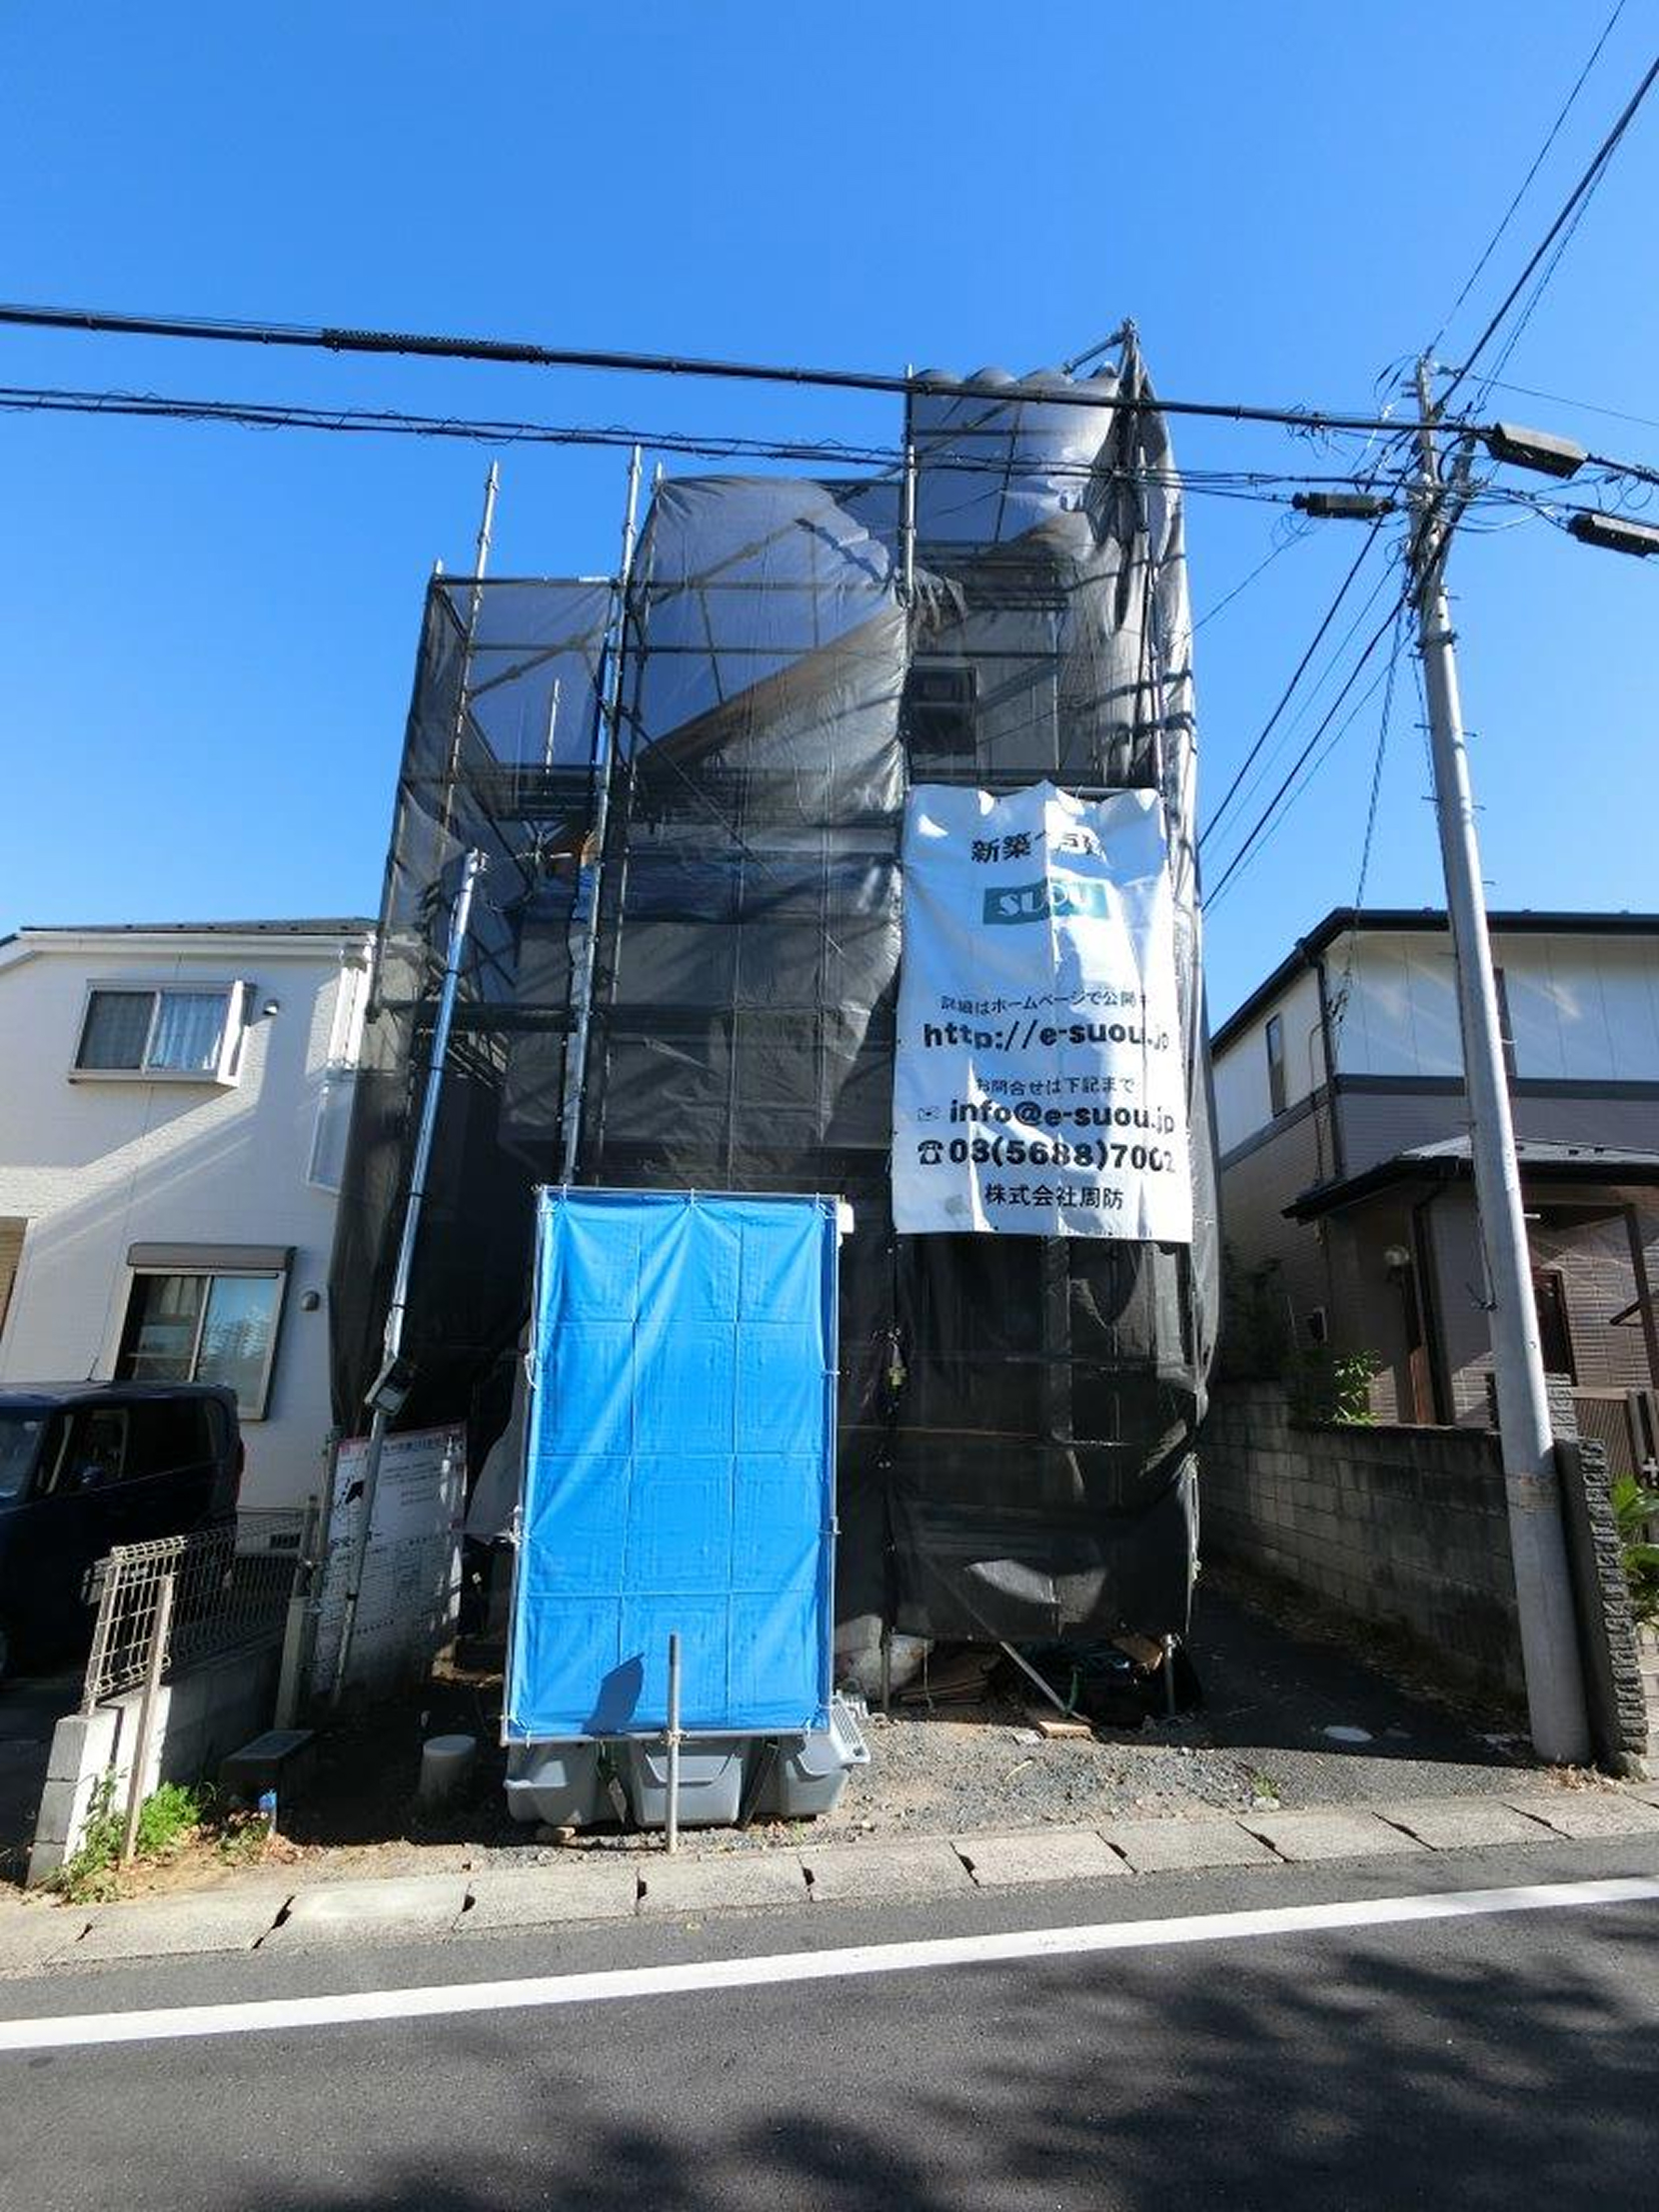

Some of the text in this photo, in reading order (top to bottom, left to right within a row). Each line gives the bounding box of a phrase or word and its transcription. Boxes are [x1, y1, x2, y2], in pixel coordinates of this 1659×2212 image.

[923, 1019, 1169, 1052] http://e-suou.jp
[976, 1076, 1135, 1096] お問合せは下記まで
[949, 1099, 1175, 1134] info@e-suou.jp
[985, 1183, 1124, 1211] 株式会社周防
